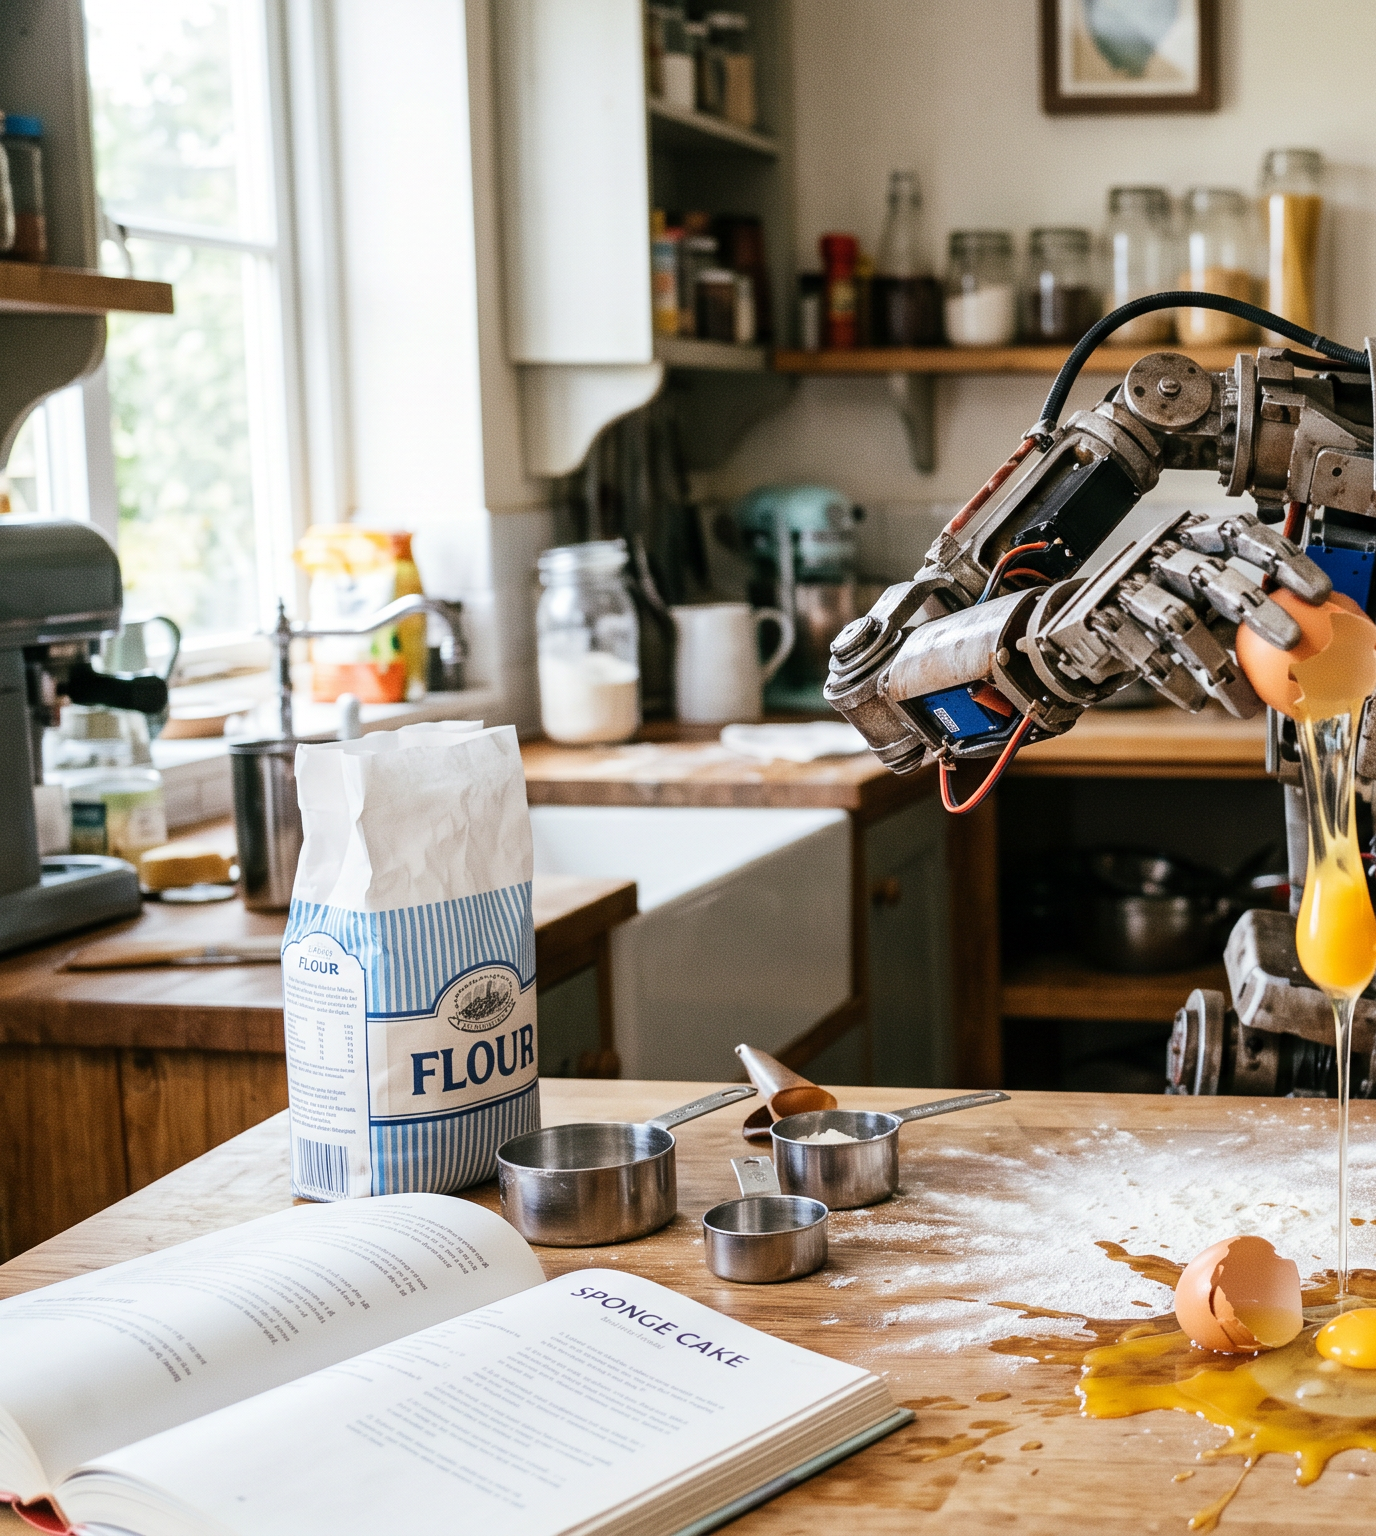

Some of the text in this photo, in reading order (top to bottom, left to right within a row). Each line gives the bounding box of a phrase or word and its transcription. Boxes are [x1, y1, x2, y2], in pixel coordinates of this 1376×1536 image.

[298, 956, 340, 976] FLOUR
[410, 1023, 534, 1096] FLOUR
[570, 1286, 679, 1337] SPONGE
[675, 1332, 750, 1368] CAKE
